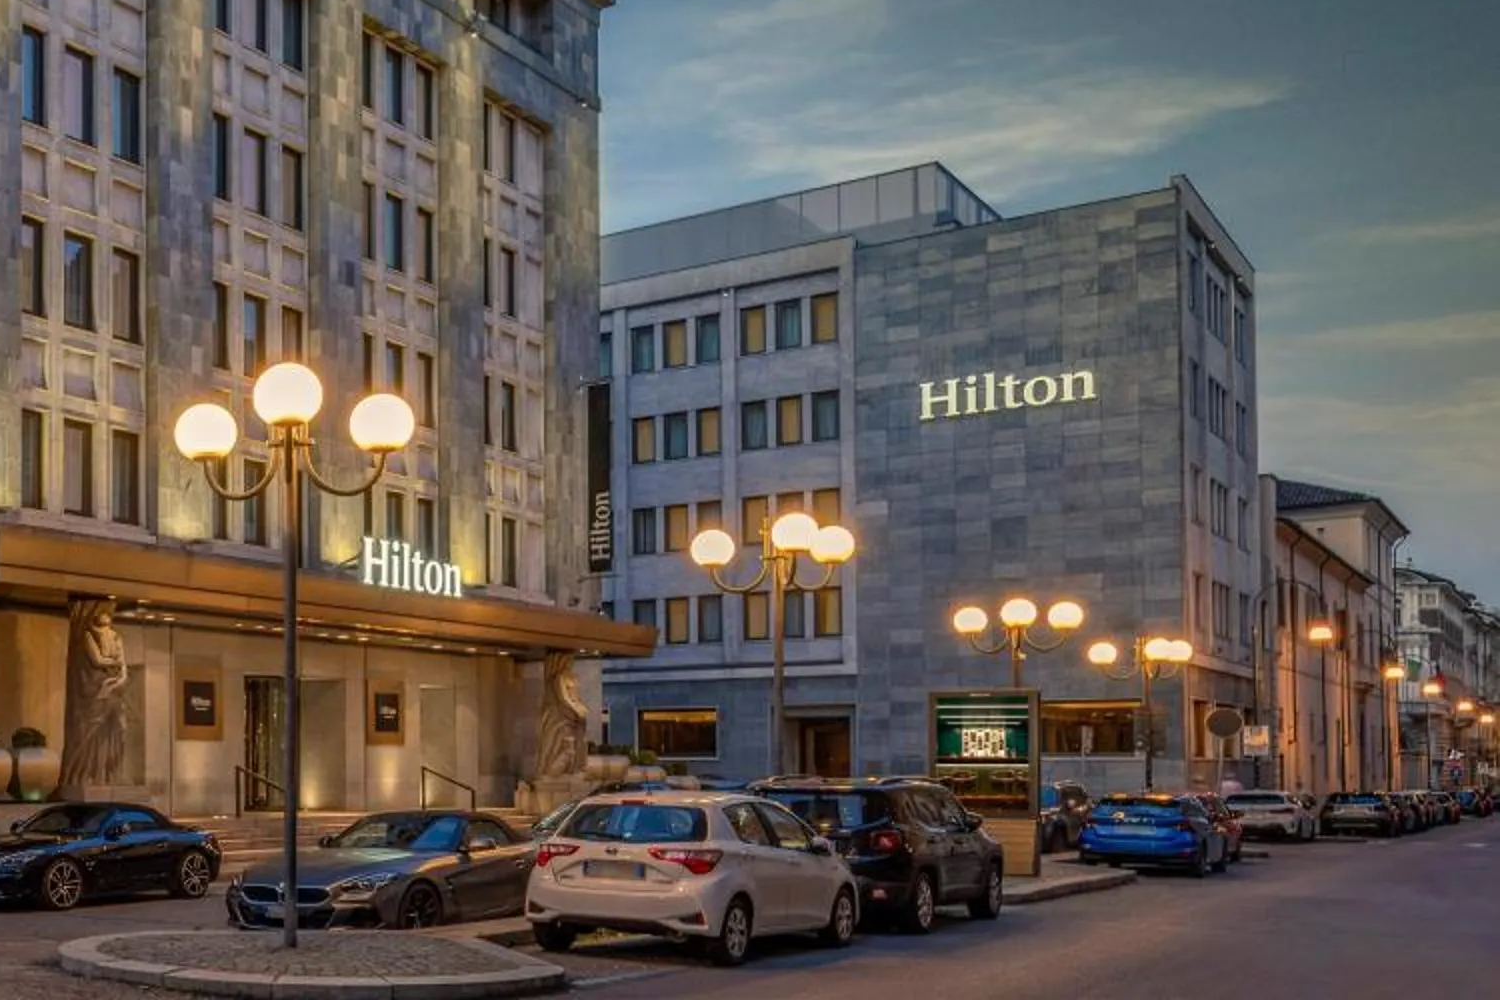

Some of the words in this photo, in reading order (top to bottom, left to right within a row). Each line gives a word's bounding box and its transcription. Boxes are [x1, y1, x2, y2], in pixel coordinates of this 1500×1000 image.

[919, 370, 1097, 420] Hilton
[590, 490, 610, 560] Hilton
[363, 536, 462, 597] Hilton
